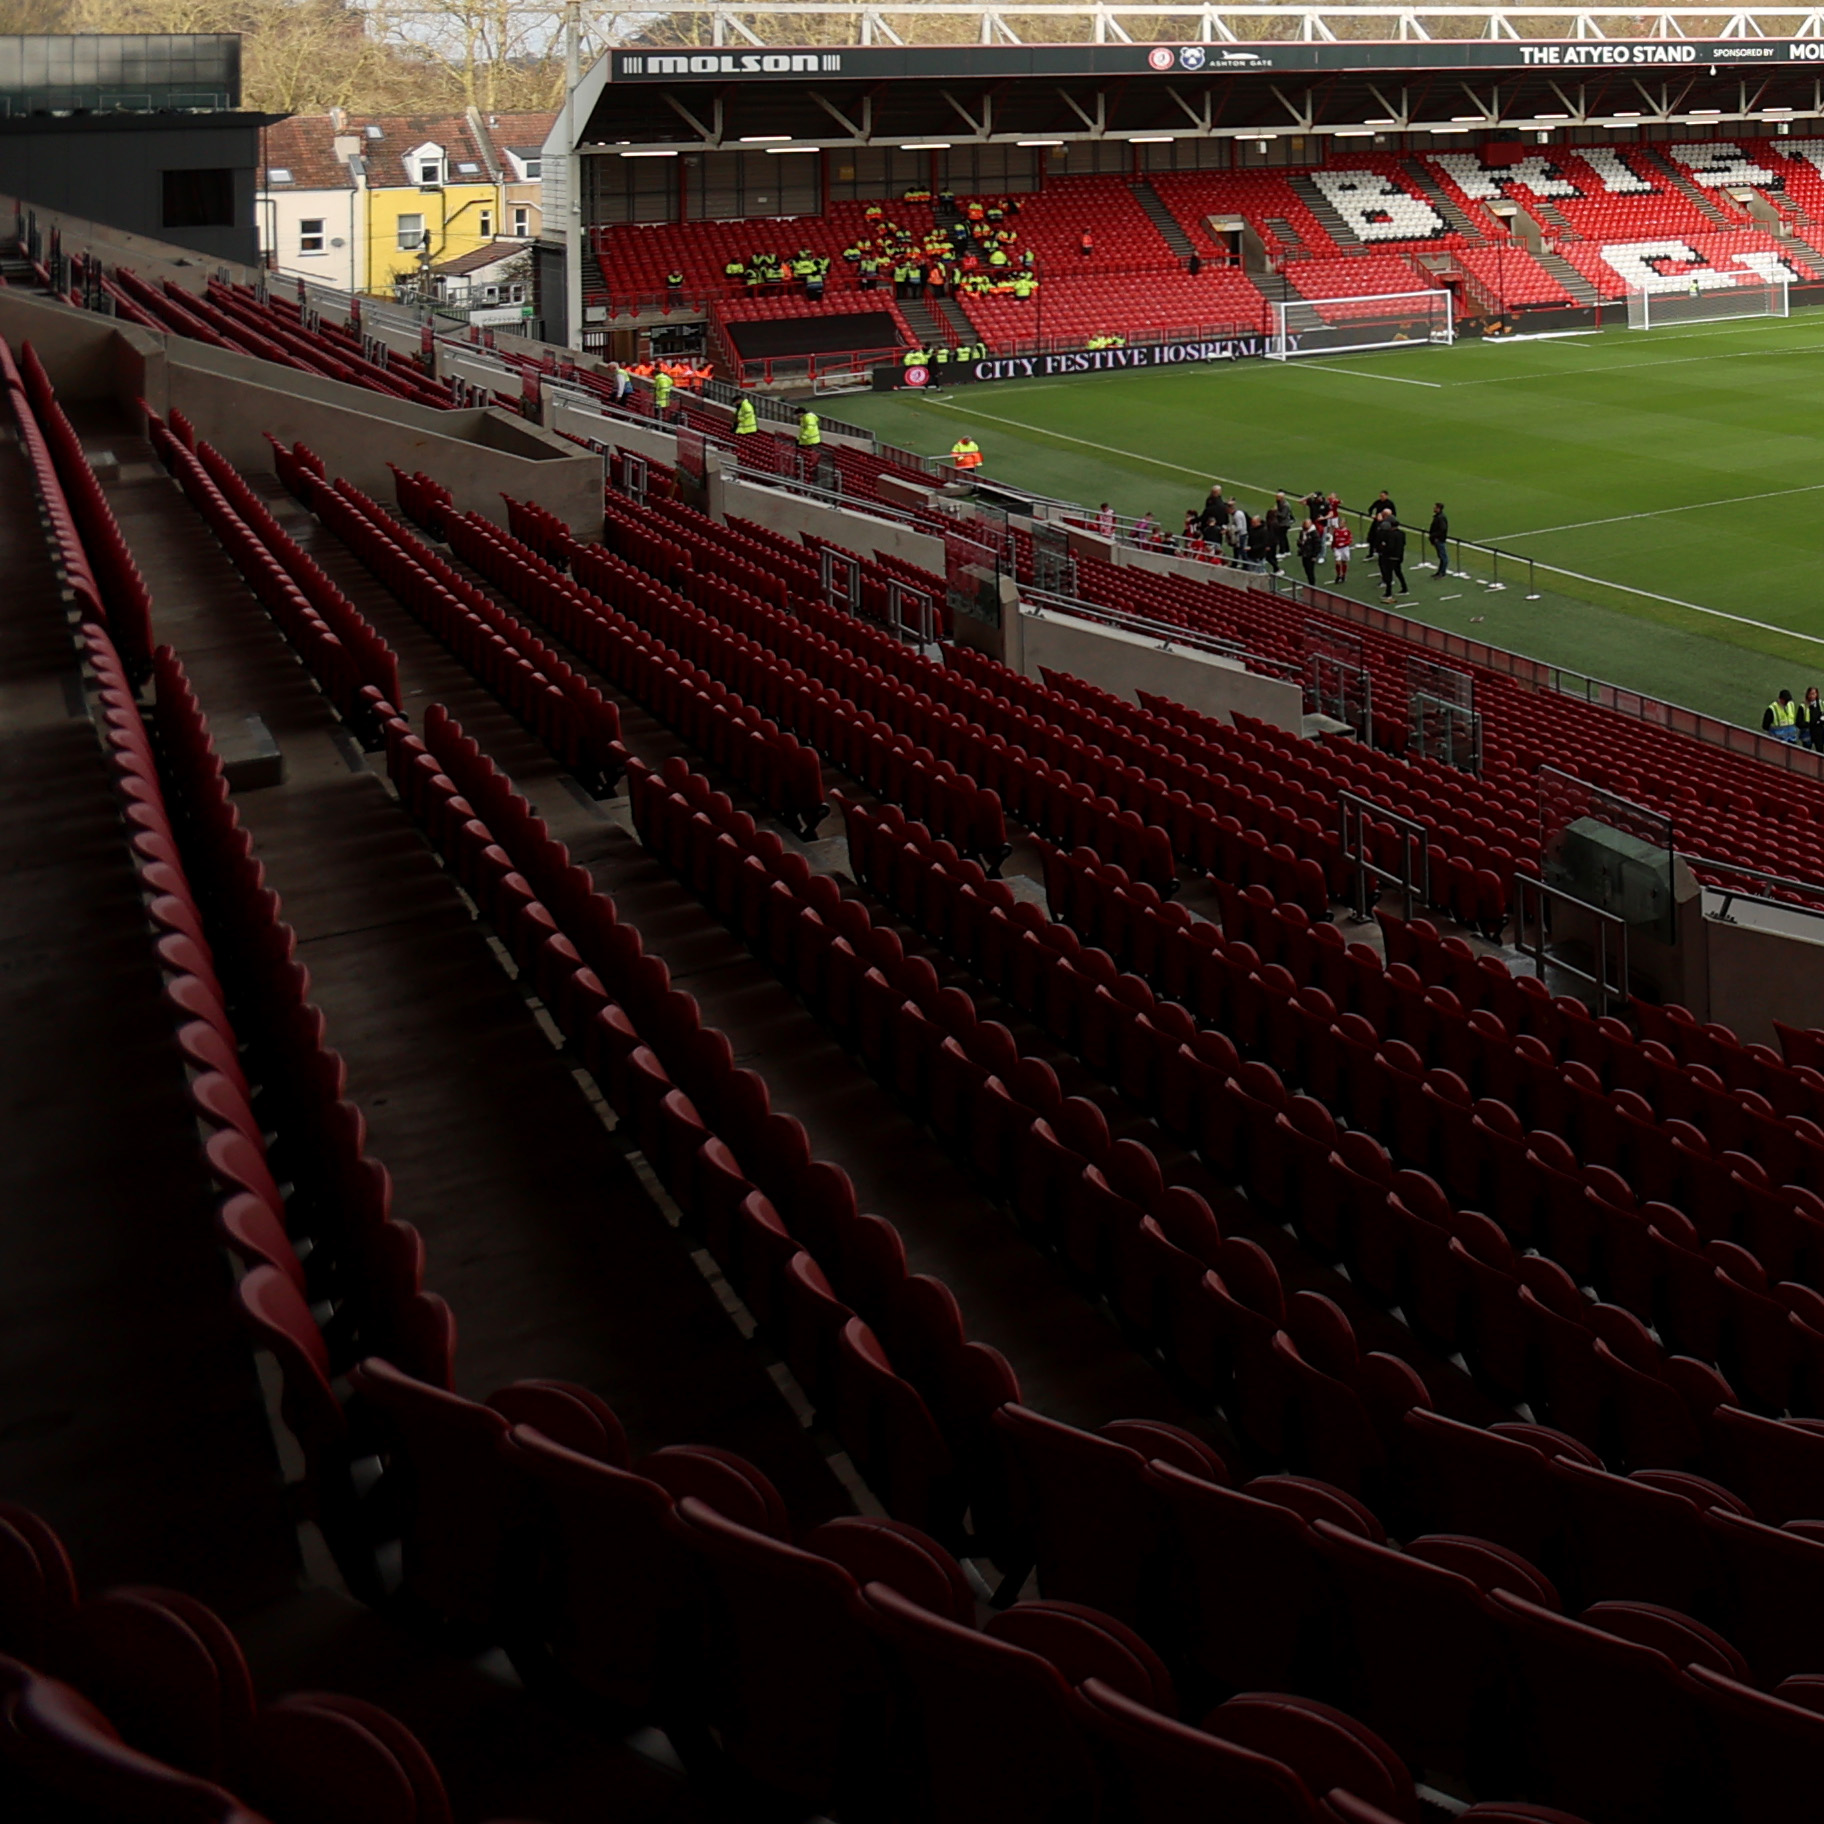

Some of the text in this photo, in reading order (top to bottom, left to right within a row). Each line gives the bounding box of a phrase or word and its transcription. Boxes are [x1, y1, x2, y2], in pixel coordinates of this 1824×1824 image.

[1520, 46, 1696, 64] THE ATYEO STAND
[1713, 49, 1762, 57] SPONSORED
[647, 55, 819, 74] MOLSON
[976, 335, 1304, 380] CITY FESTIVE HOSPITALITY
